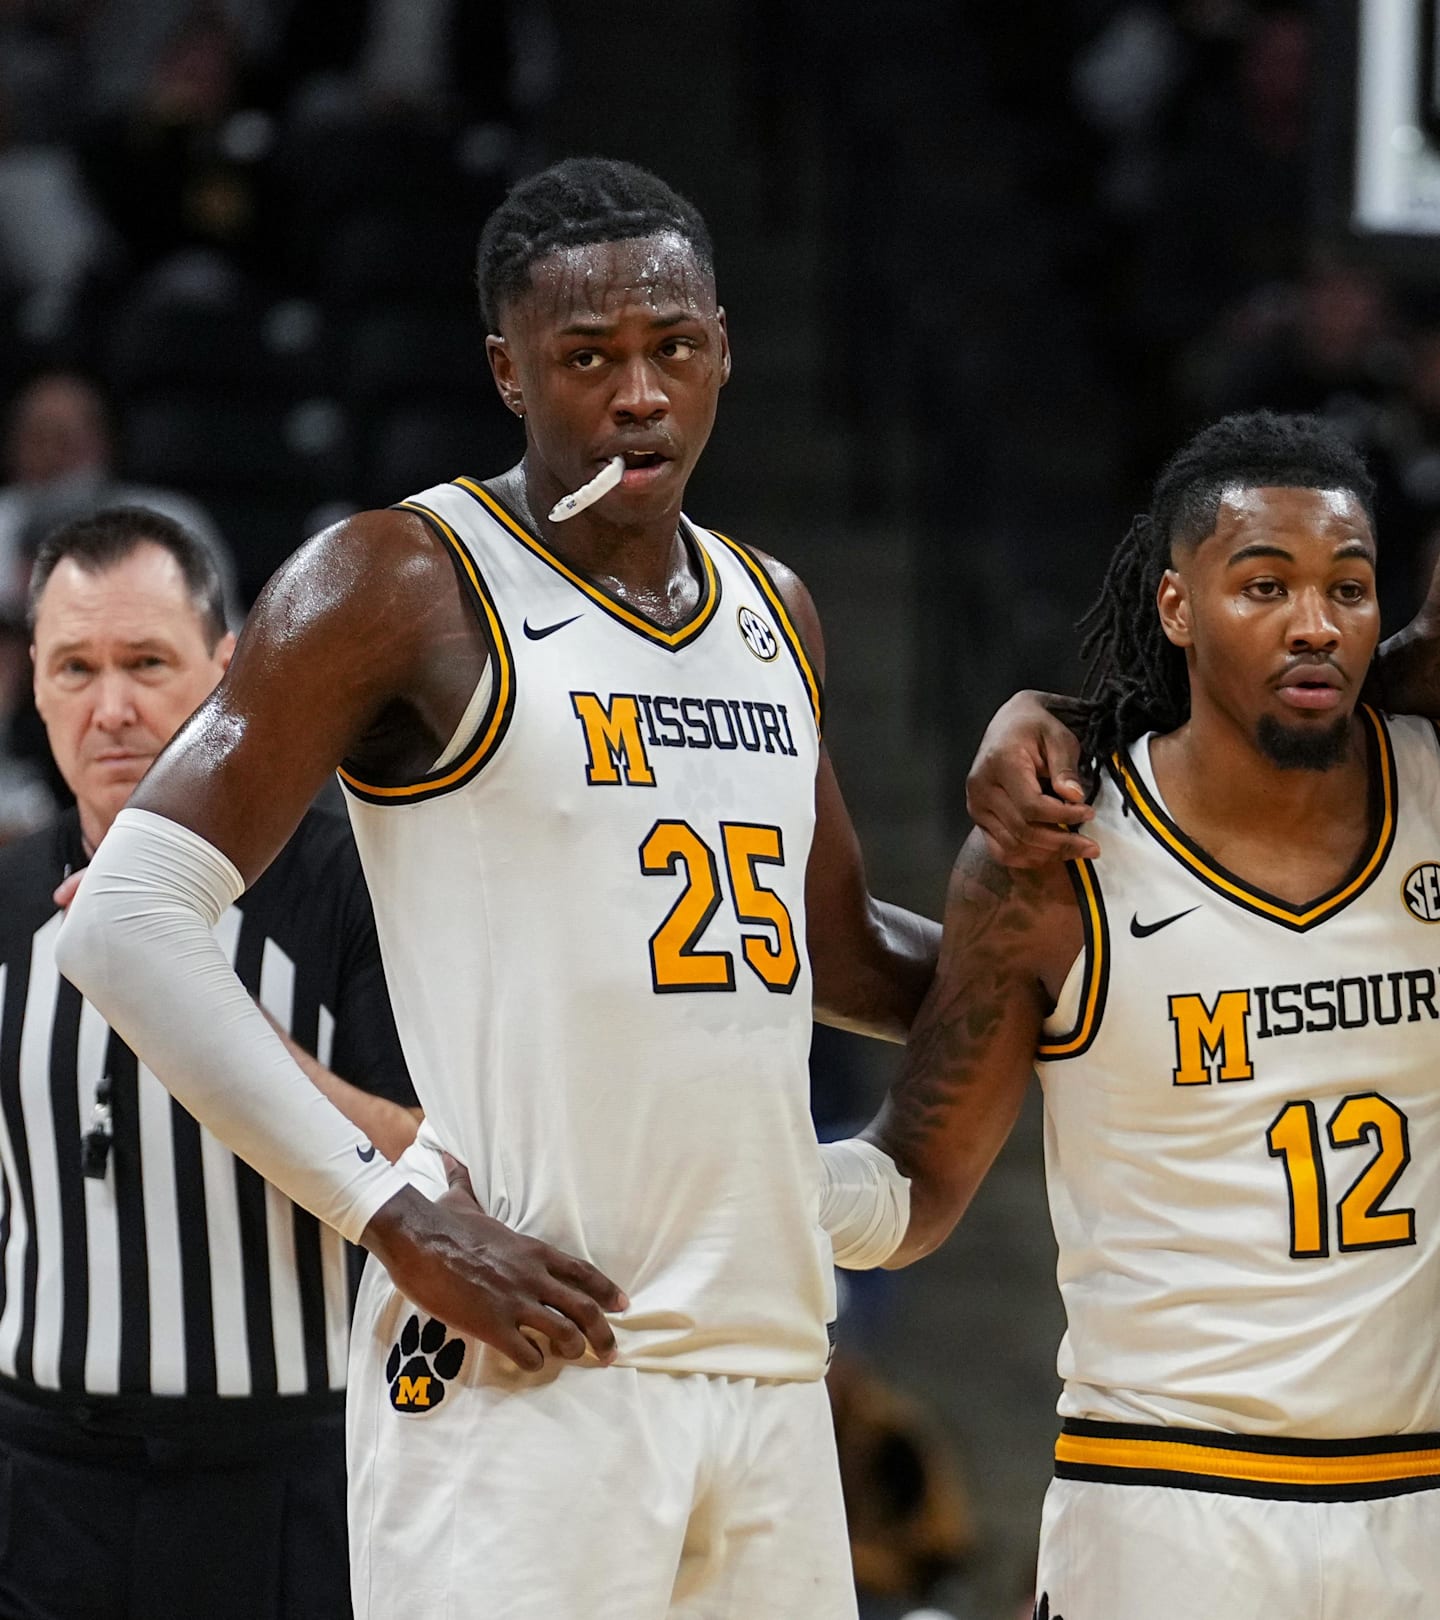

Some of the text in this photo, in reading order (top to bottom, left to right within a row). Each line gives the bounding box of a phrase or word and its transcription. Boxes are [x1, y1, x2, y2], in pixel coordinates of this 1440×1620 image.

[569, 691, 798, 787] MISSOURI
[639, 819, 801, 994] 25
[1265, 1091, 1417, 1259] 12
[395, 1375, 432, 1406] M
